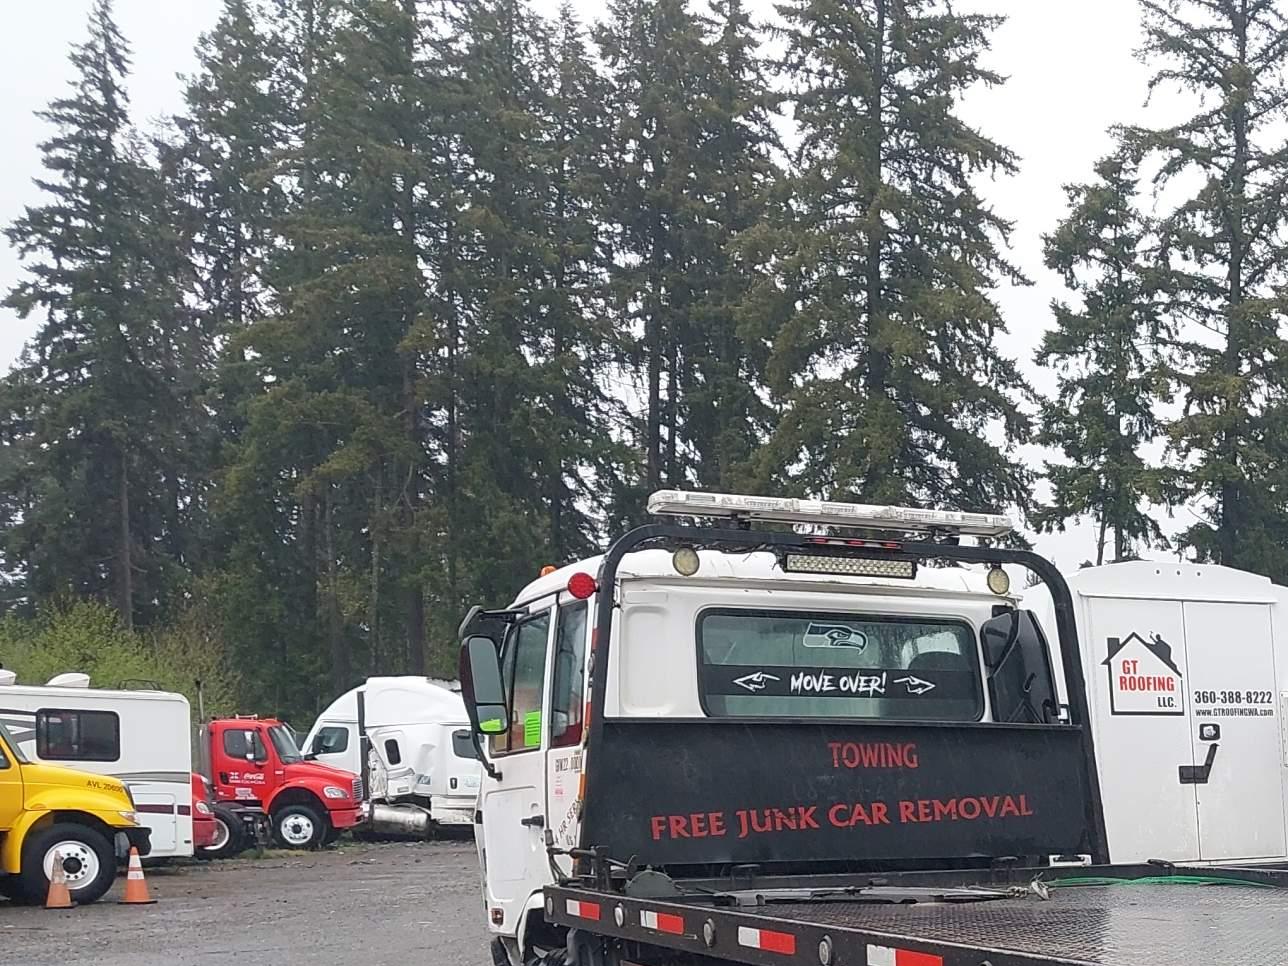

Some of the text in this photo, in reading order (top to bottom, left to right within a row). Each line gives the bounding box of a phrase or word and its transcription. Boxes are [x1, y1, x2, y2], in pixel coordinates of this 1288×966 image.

[1122, 659, 1138, 675] GT
[790, 670, 887, 697] MOVE OVER!
[1119, 675, 1175, 692] ROOFING
[1157, 696, 1177, 708] LLC.
[1194, 690, 1273, 704] 360-388-8222
[828, 742, 920, 769] TOWING
[651, 794, 1034, 840] FREE JUNK CAR REMOVAL
